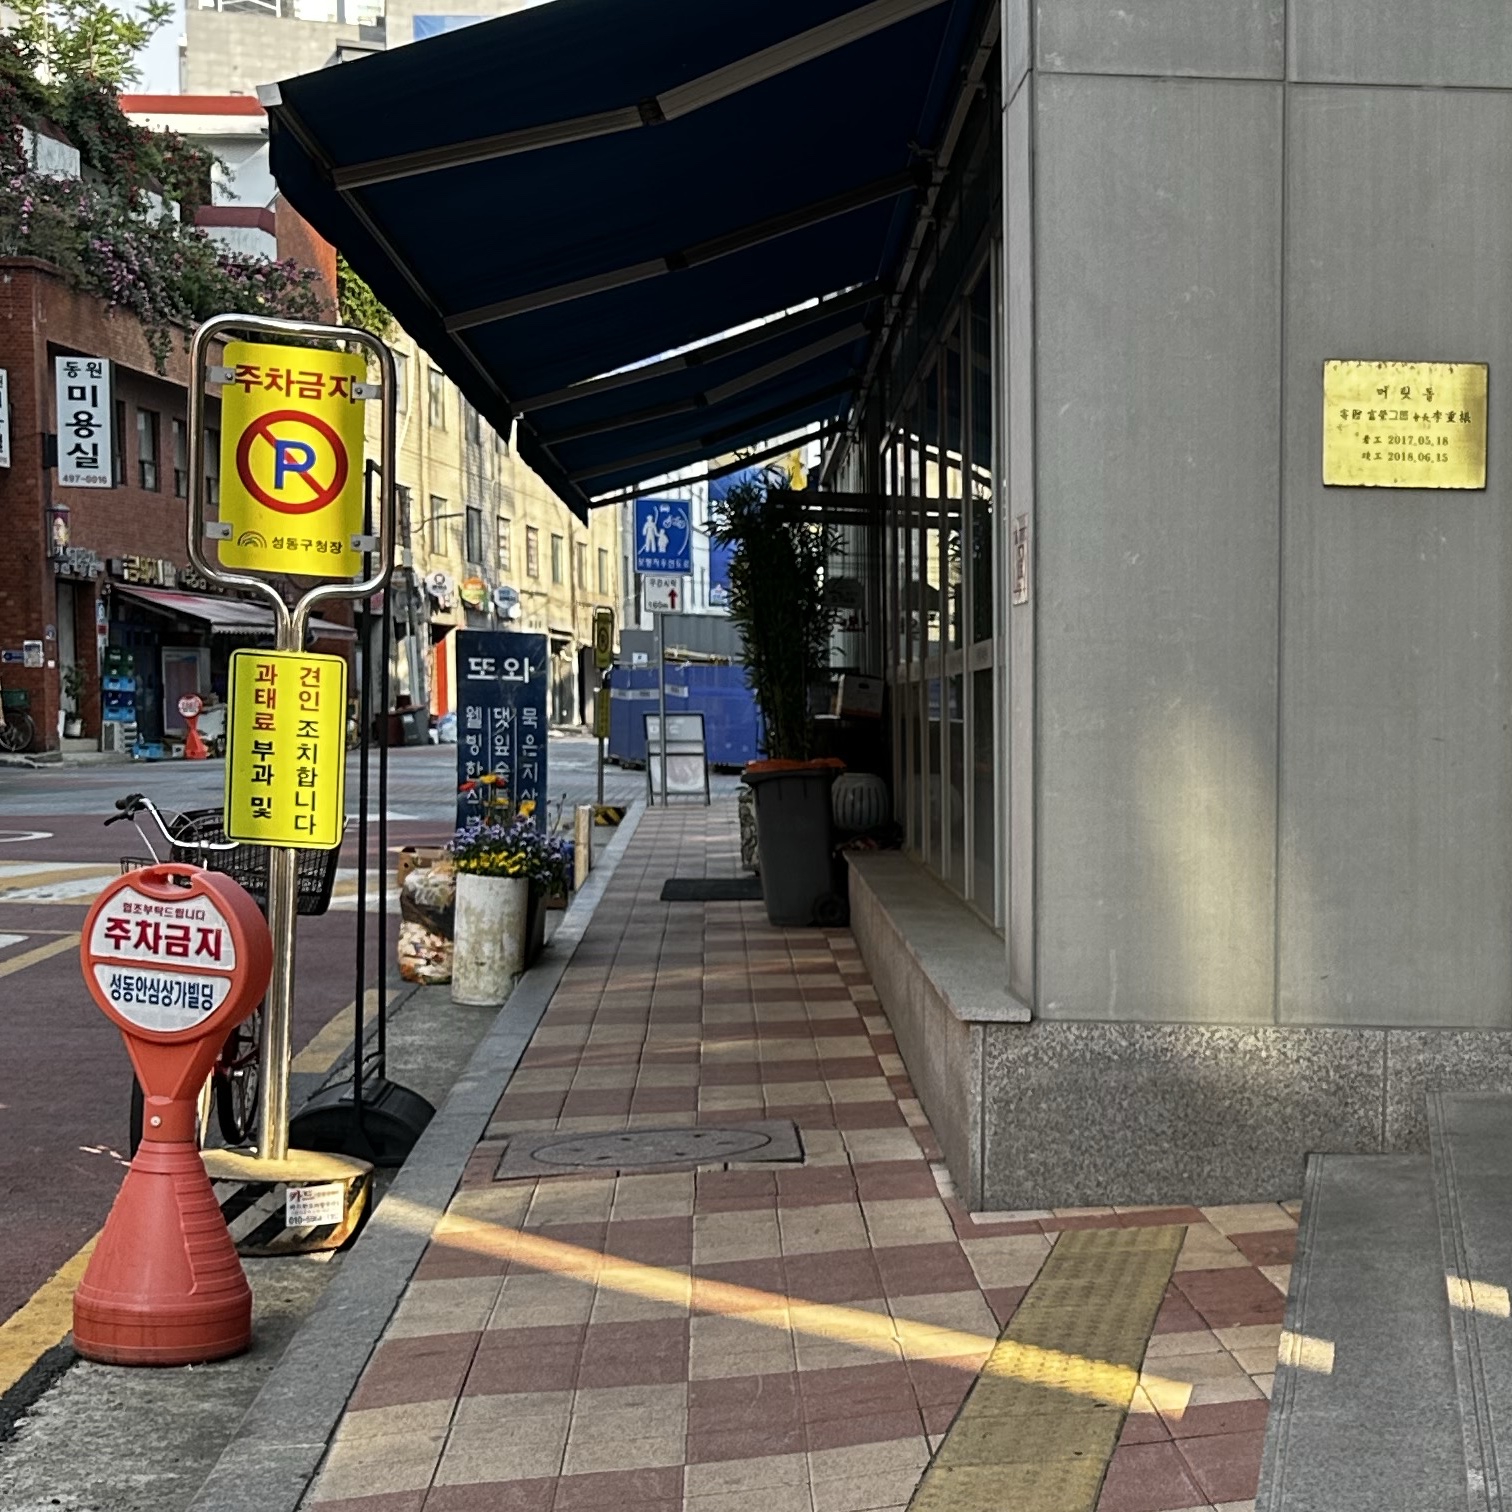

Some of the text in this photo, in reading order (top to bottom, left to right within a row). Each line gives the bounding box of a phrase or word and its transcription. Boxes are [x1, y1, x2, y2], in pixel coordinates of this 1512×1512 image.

[63, 362, 102, 379] 동원
[235, 364, 357, 404] 주차금지
[1376, 385, 1434, 402] 머릿돌
[65, 385, 102, 469] 미용실
[272, 536, 342, 554] 성동구청장
[251, 664, 278, 819] 과태료 부과 및
[294, 666, 320, 836] 견인 조치합니다
[122, 902, 206, 921] 협조부탁드립니다
[105, 917, 222, 961] 주차금지
[110, 973, 214, 1011] 성동안심상가빌딩
